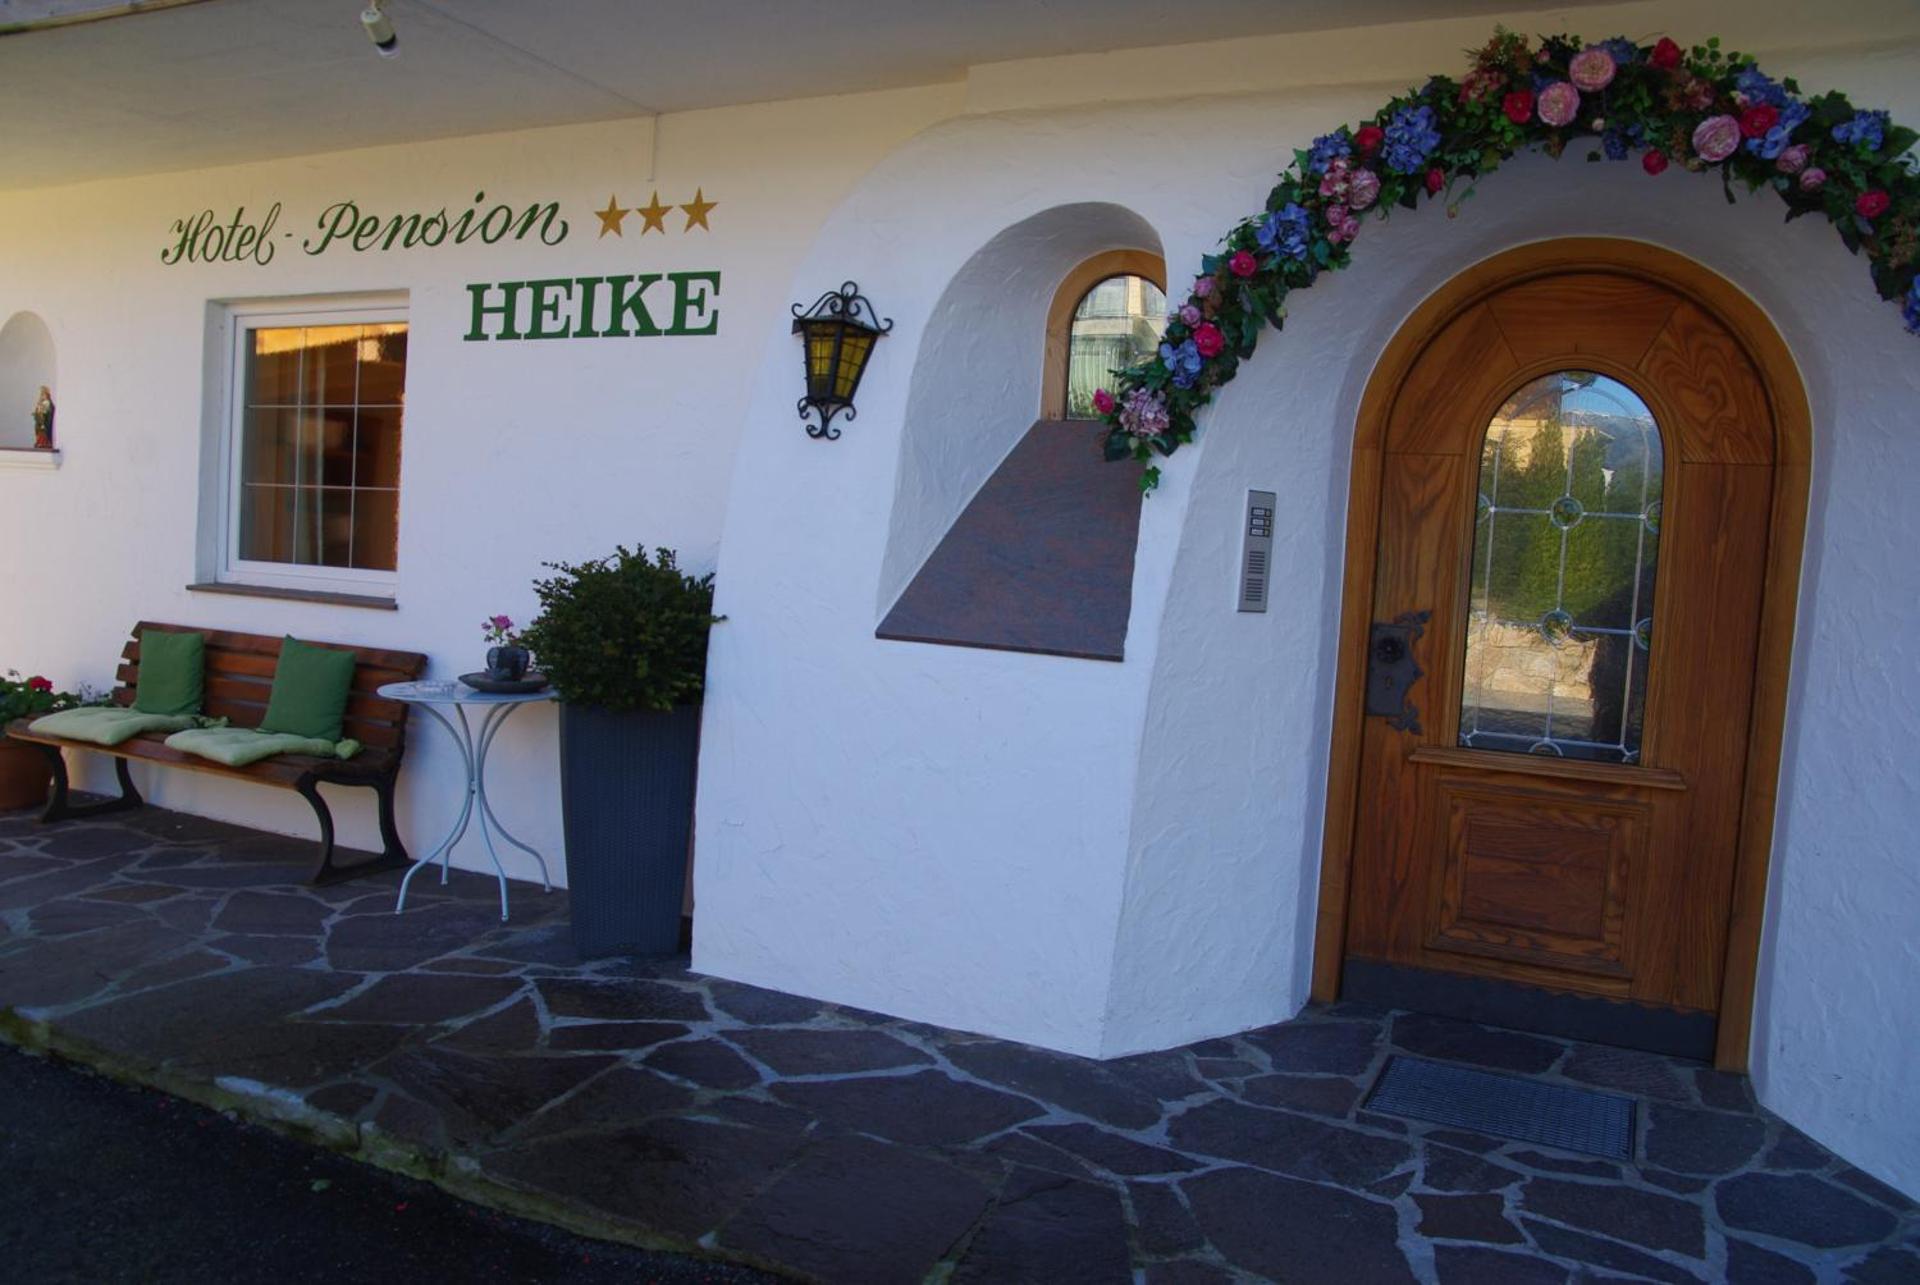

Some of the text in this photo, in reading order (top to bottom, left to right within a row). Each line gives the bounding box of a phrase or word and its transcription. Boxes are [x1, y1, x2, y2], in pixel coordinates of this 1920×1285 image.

[161, 202, 281, 266] Hotel
[303, 191, 570, 256] Pension
[463, 271, 721, 342] HEIKE
